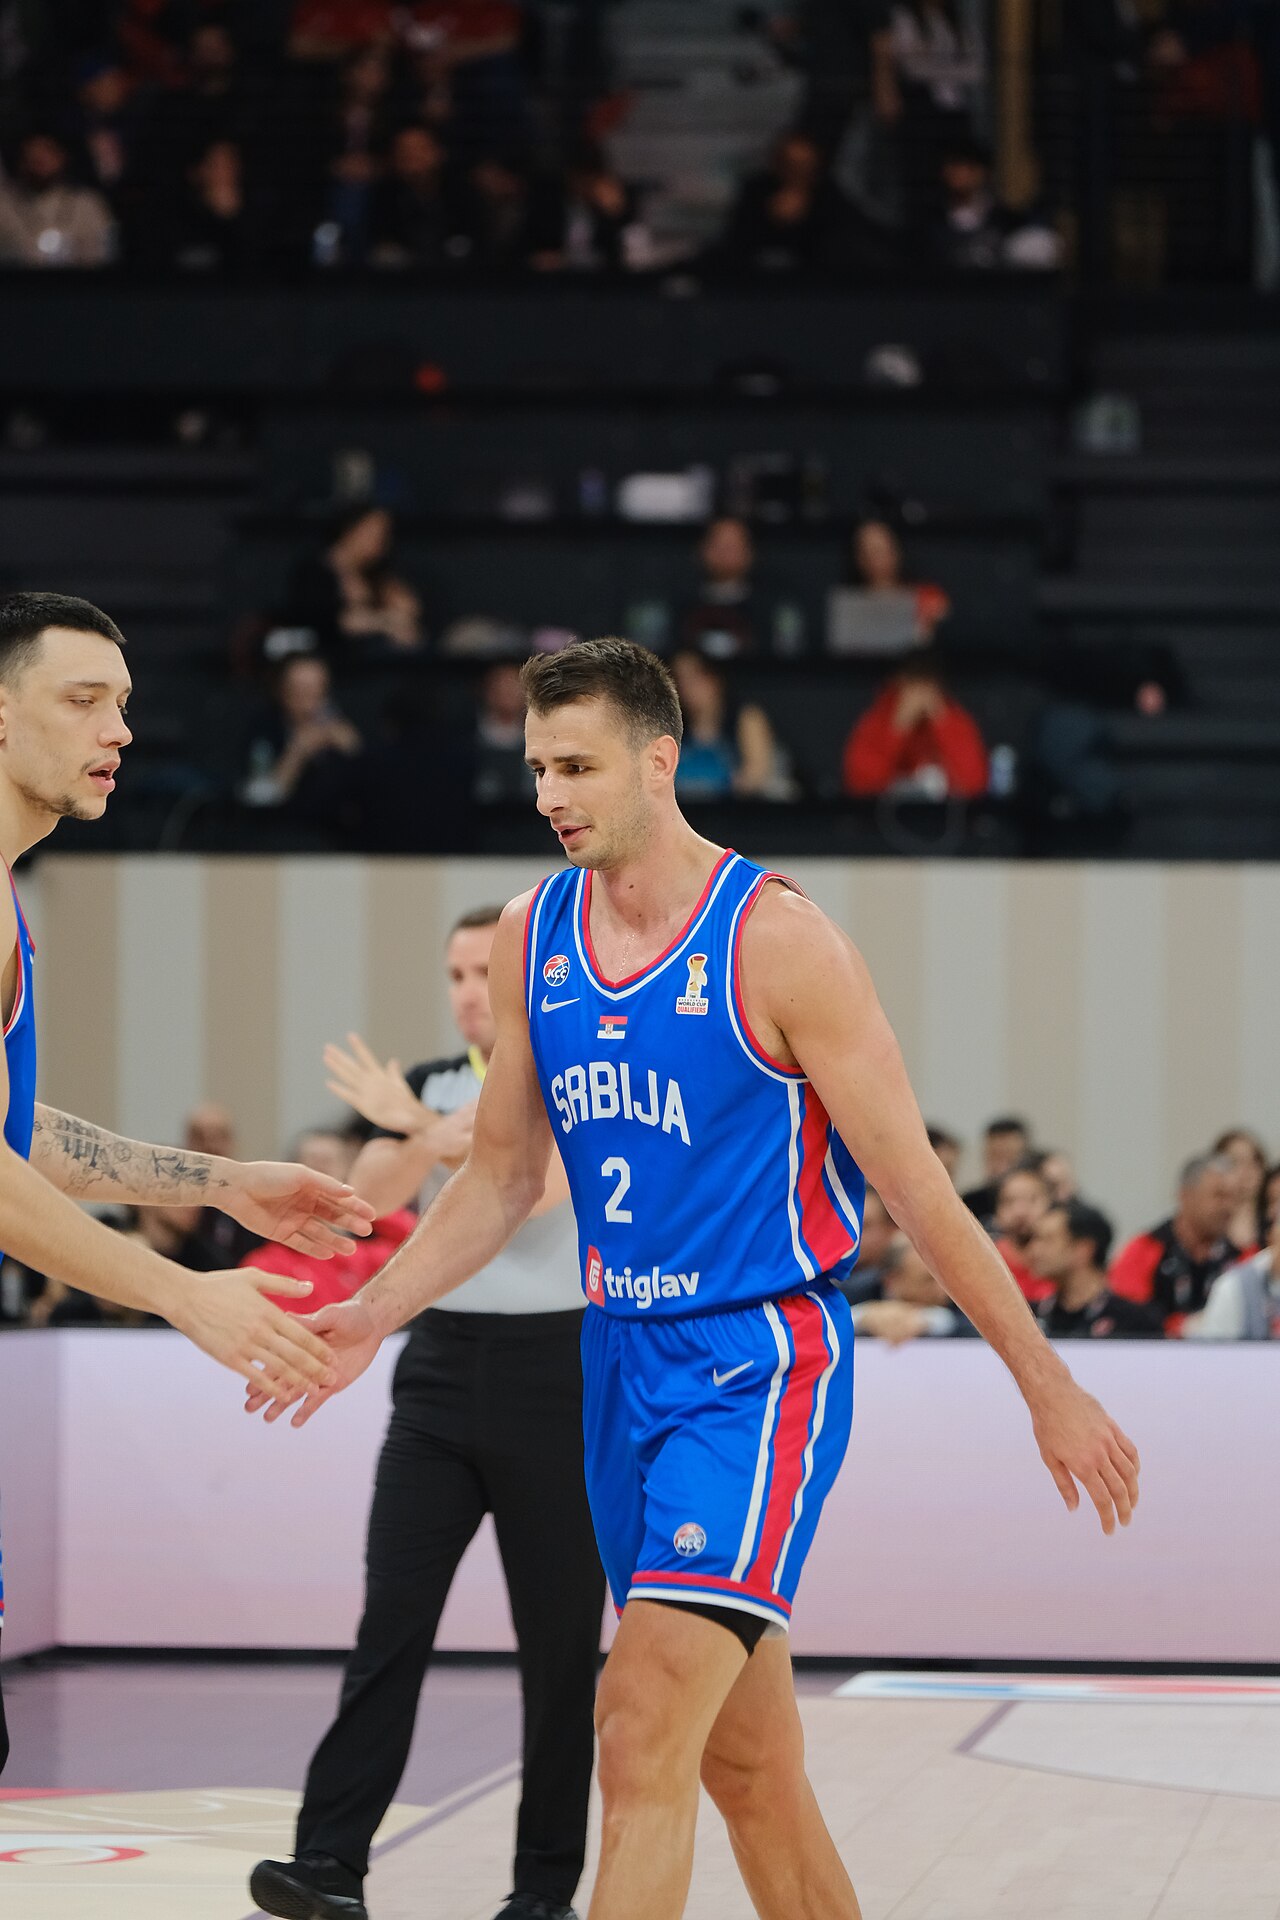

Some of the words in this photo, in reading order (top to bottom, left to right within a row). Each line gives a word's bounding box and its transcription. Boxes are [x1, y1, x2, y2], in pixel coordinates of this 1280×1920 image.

[551, 1061, 691, 1146] SRBIJA
[601, 1156, 633, 1224] 2
[604, 1266, 700, 1310] triglav
